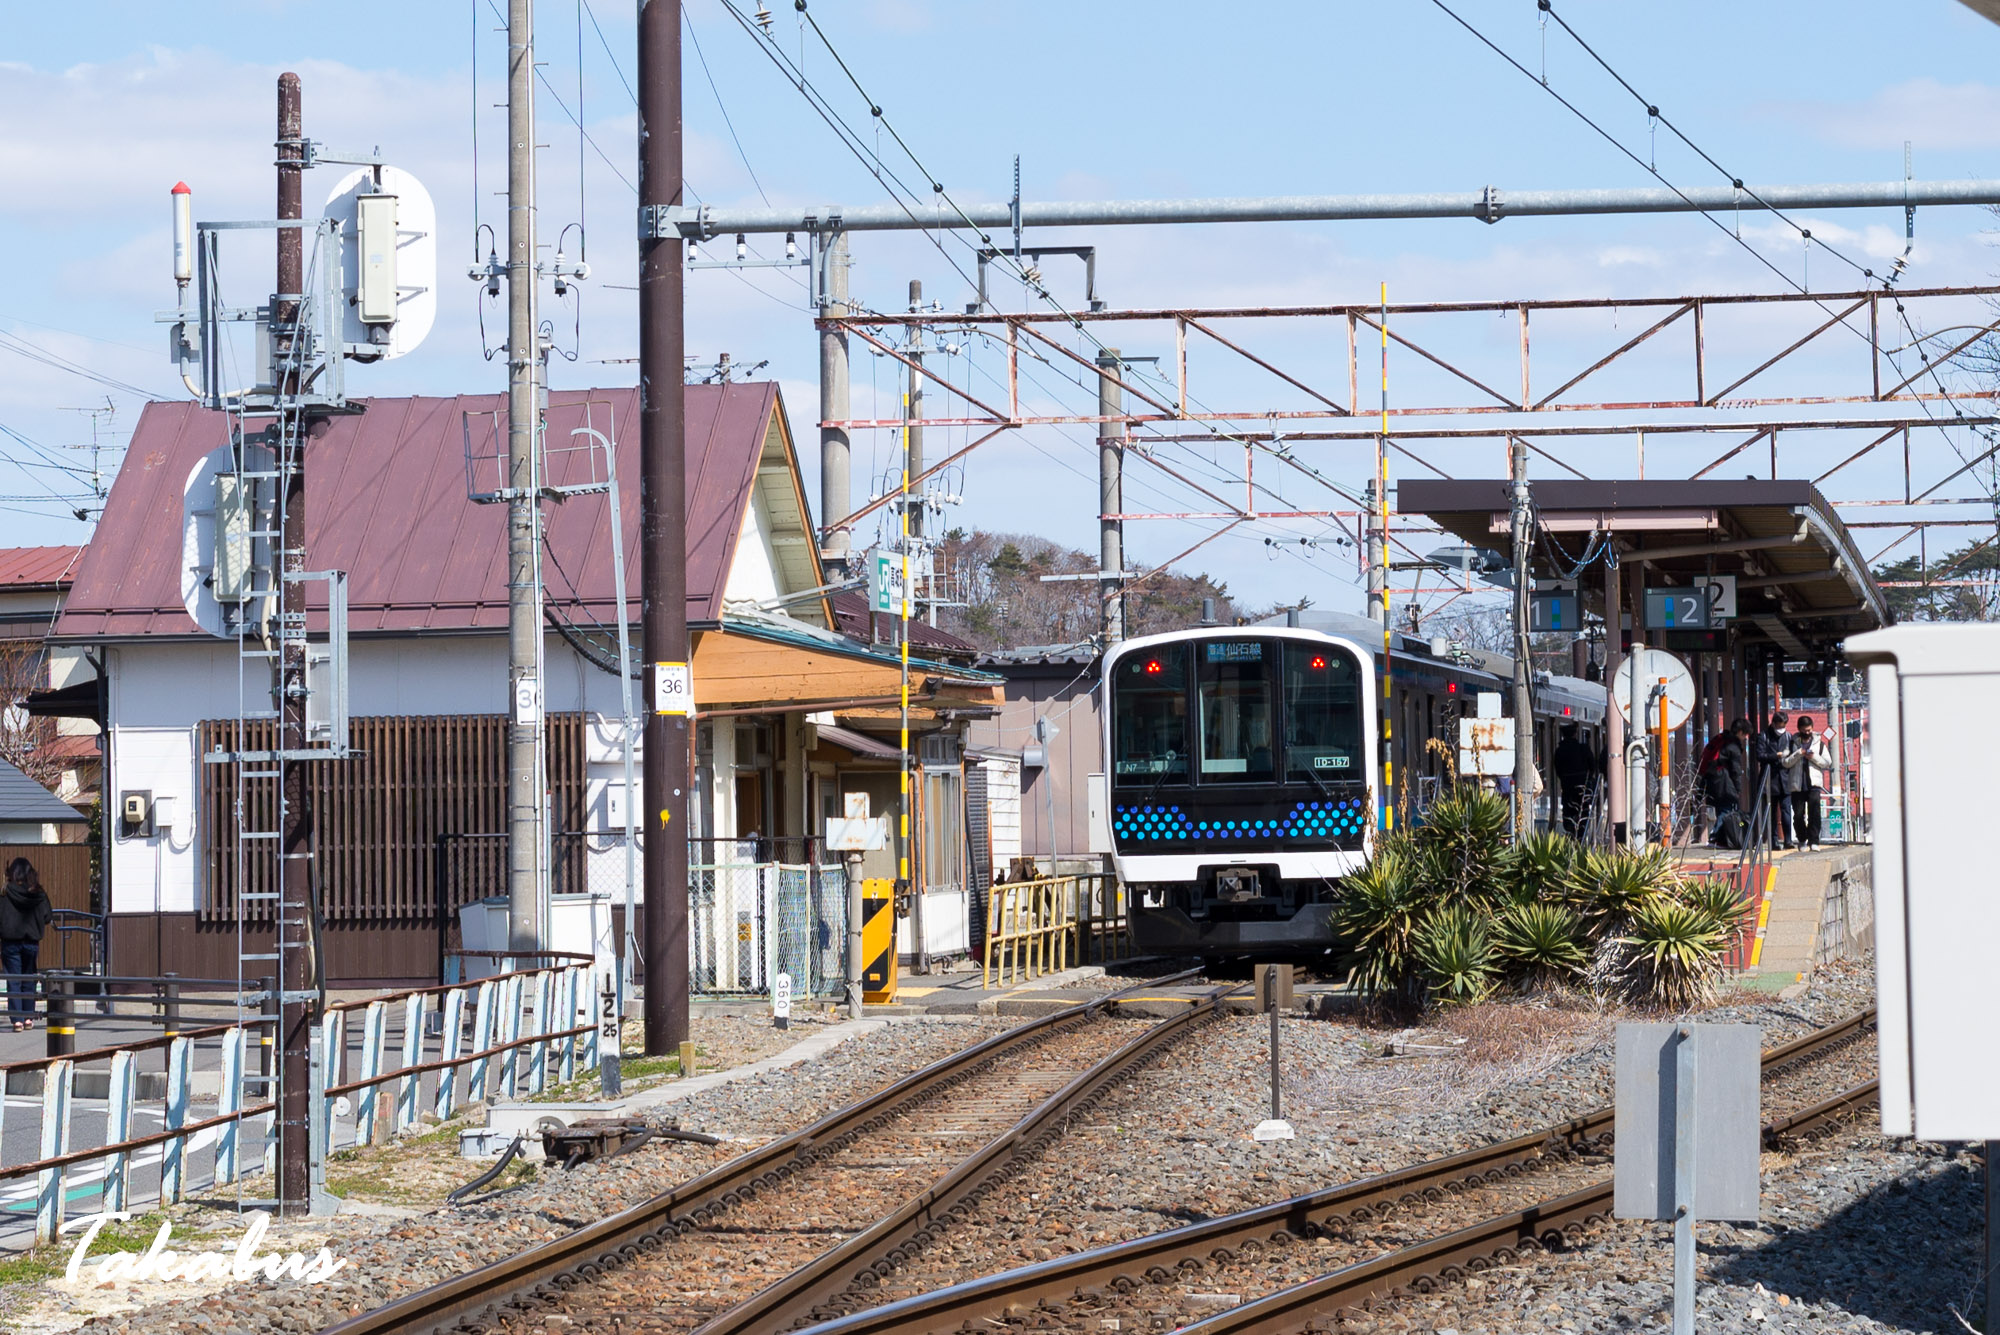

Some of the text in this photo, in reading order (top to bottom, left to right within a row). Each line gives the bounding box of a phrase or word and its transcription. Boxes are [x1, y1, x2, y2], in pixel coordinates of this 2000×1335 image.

[879, 563, 890, 593] JR
[1709, 581, 1725, 612] 2
[1531, 600, 1541, 626] 1
[1681, 597, 1698, 623] 2
[1227, 643, 1262, 656] 仙石線
[662, 679, 683, 694] 36
[1808, 678, 1819, 695] 2
[518, 689, 537, 709] 3
[778, 980, 789, 1009] 360
[603, 1023, 617, 1037] 25
